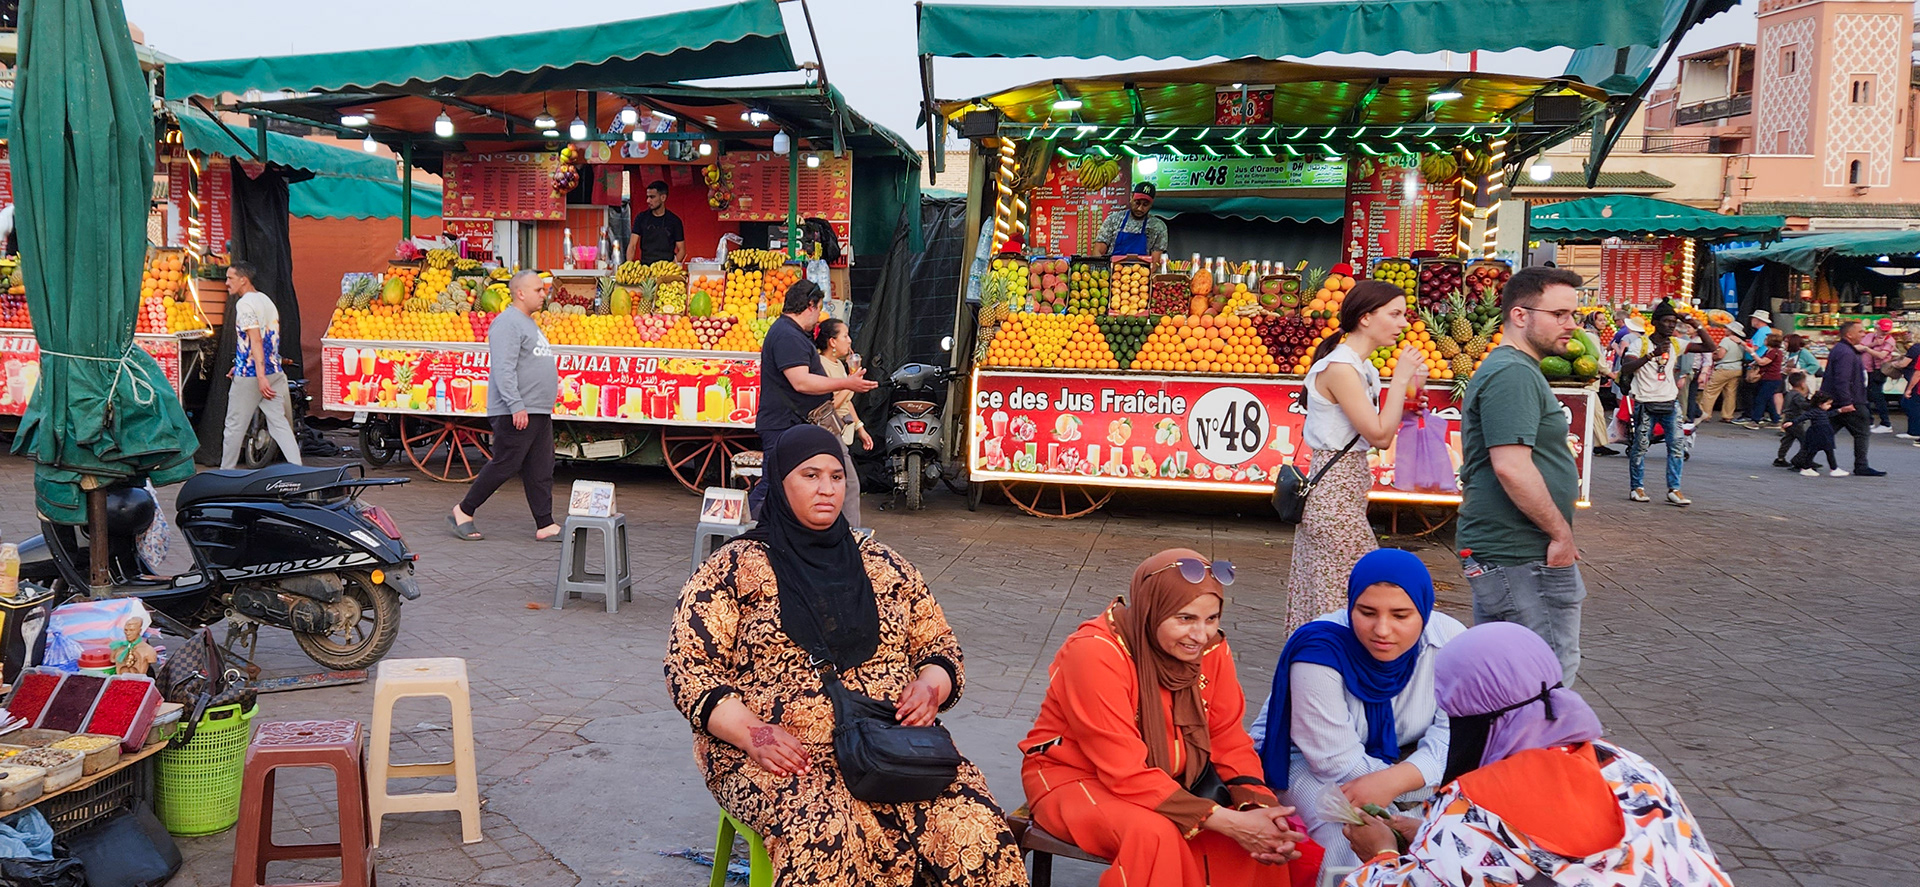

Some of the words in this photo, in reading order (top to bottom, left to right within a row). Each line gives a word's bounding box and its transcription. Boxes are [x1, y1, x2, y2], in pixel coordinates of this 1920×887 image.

[479, 153, 530, 163] N°50
[1292, 162, 1304, 171] DH
[1190, 165, 1229, 186] N°48
[617, 357, 632, 373] N
[635, 358, 658, 374] 50
[1008, 386, 1050, 411] des
[1053, 387, 1096, 412] Jus
[1099, 388, 1188, 415] Fraîche
[1195, 400, 1262, 453] N°48
